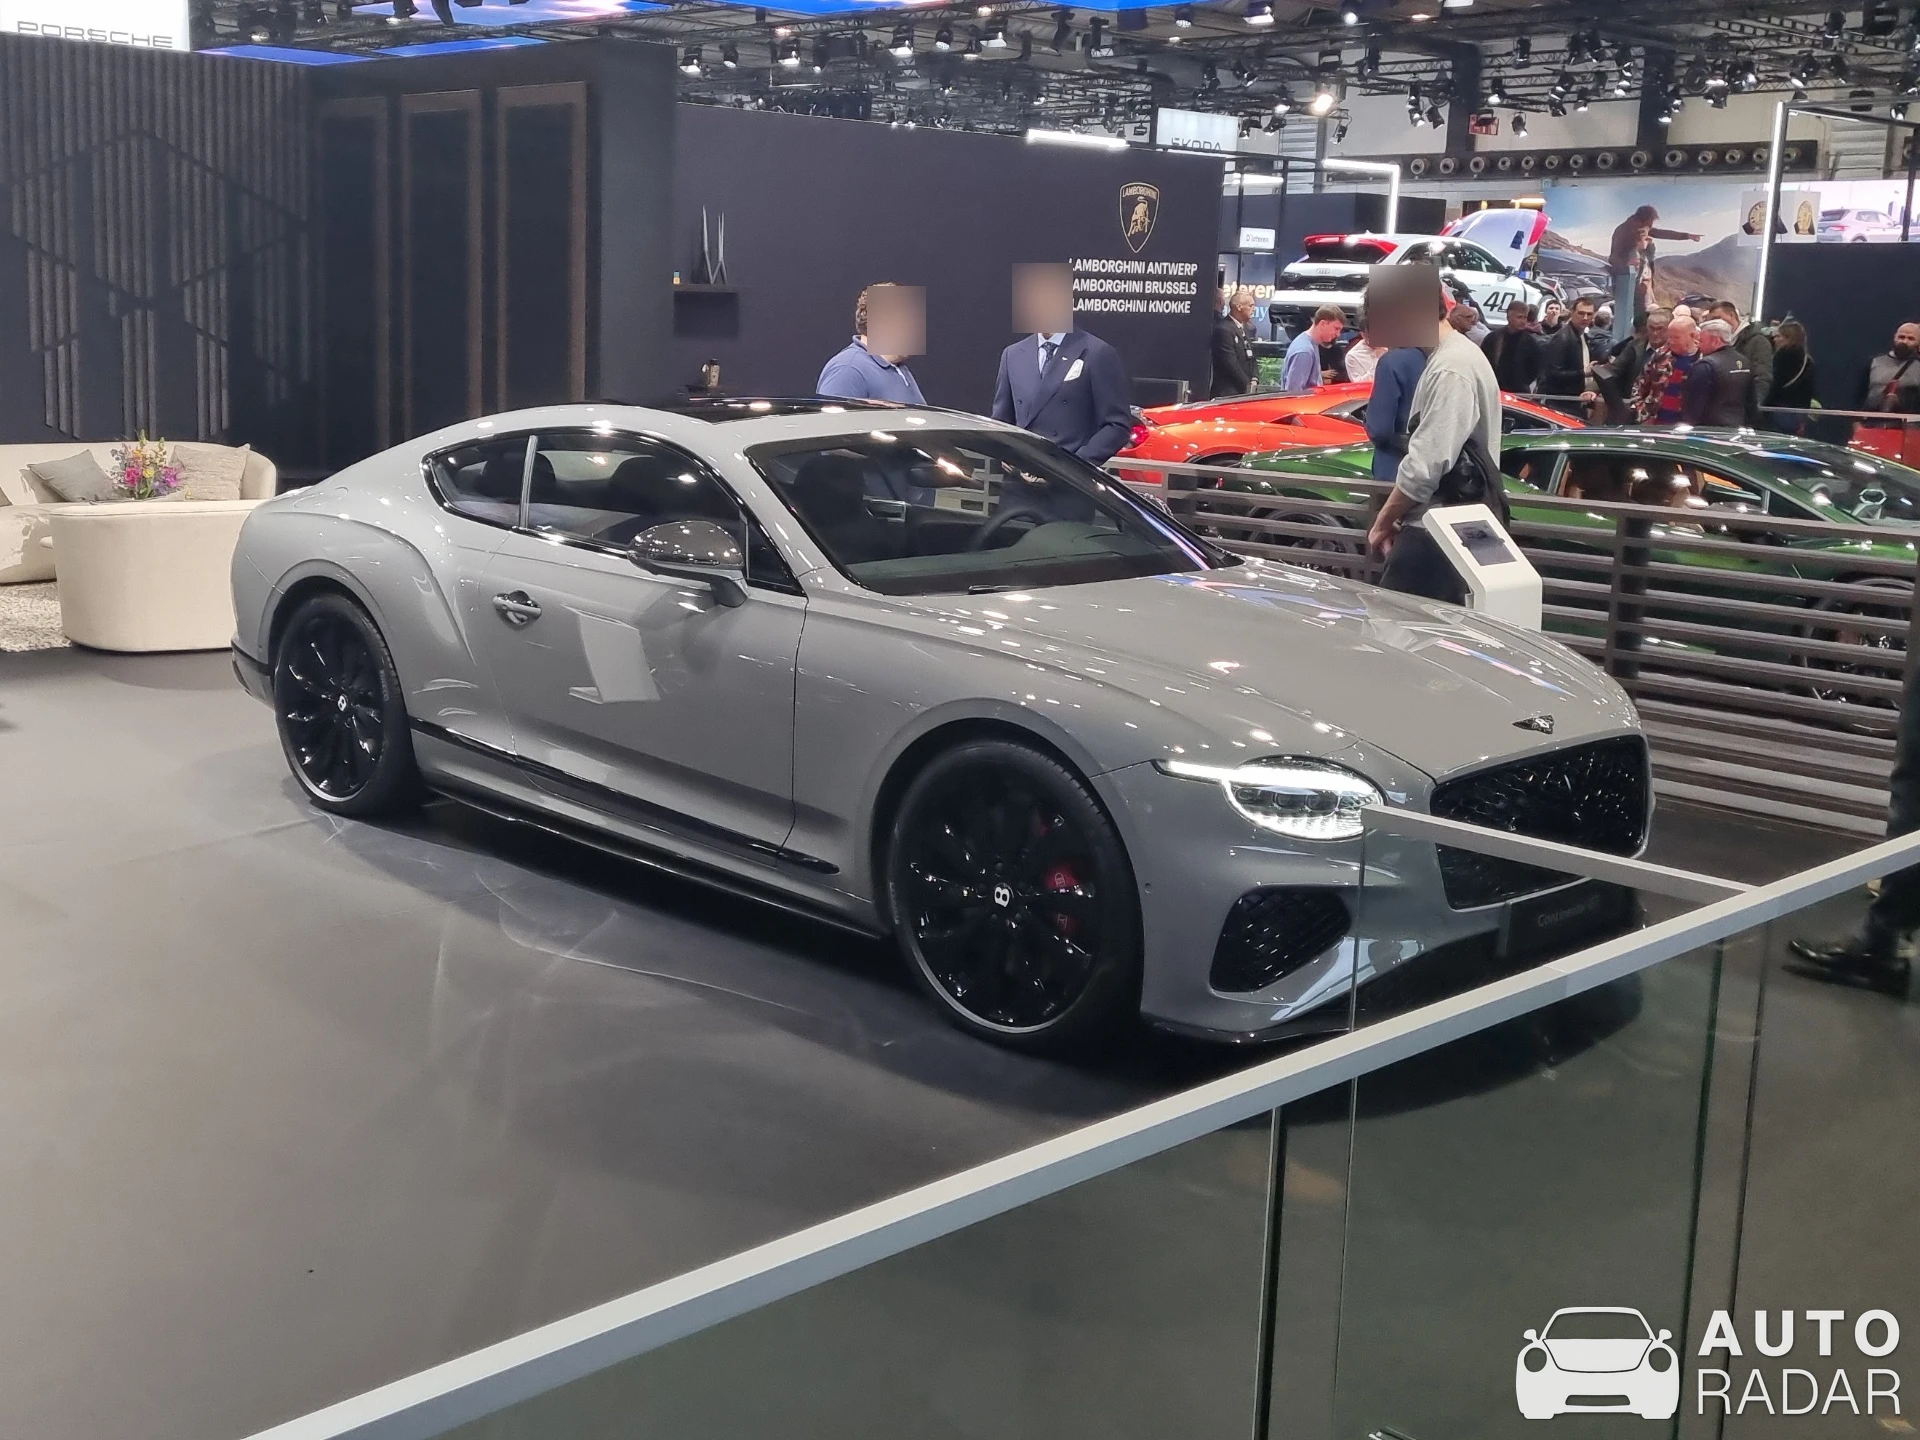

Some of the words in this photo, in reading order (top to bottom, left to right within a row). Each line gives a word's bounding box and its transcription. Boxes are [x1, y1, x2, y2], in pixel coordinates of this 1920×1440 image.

[17, 20, 173, 49] PORSCHE
[1069, 257, 1146, 274] AMBORGHINI
[1146, 261, 1198, 276] ANTWERP
[1072, 278, 1144, 294] AMBORGHINI
[1144, 281, 1198, 296] BRUSSELS
[1223, 281, 1276, 299] eteren
[1148, 300, 1192, 314] KNOKKE
[1482, 291, 1517, 313] 40
